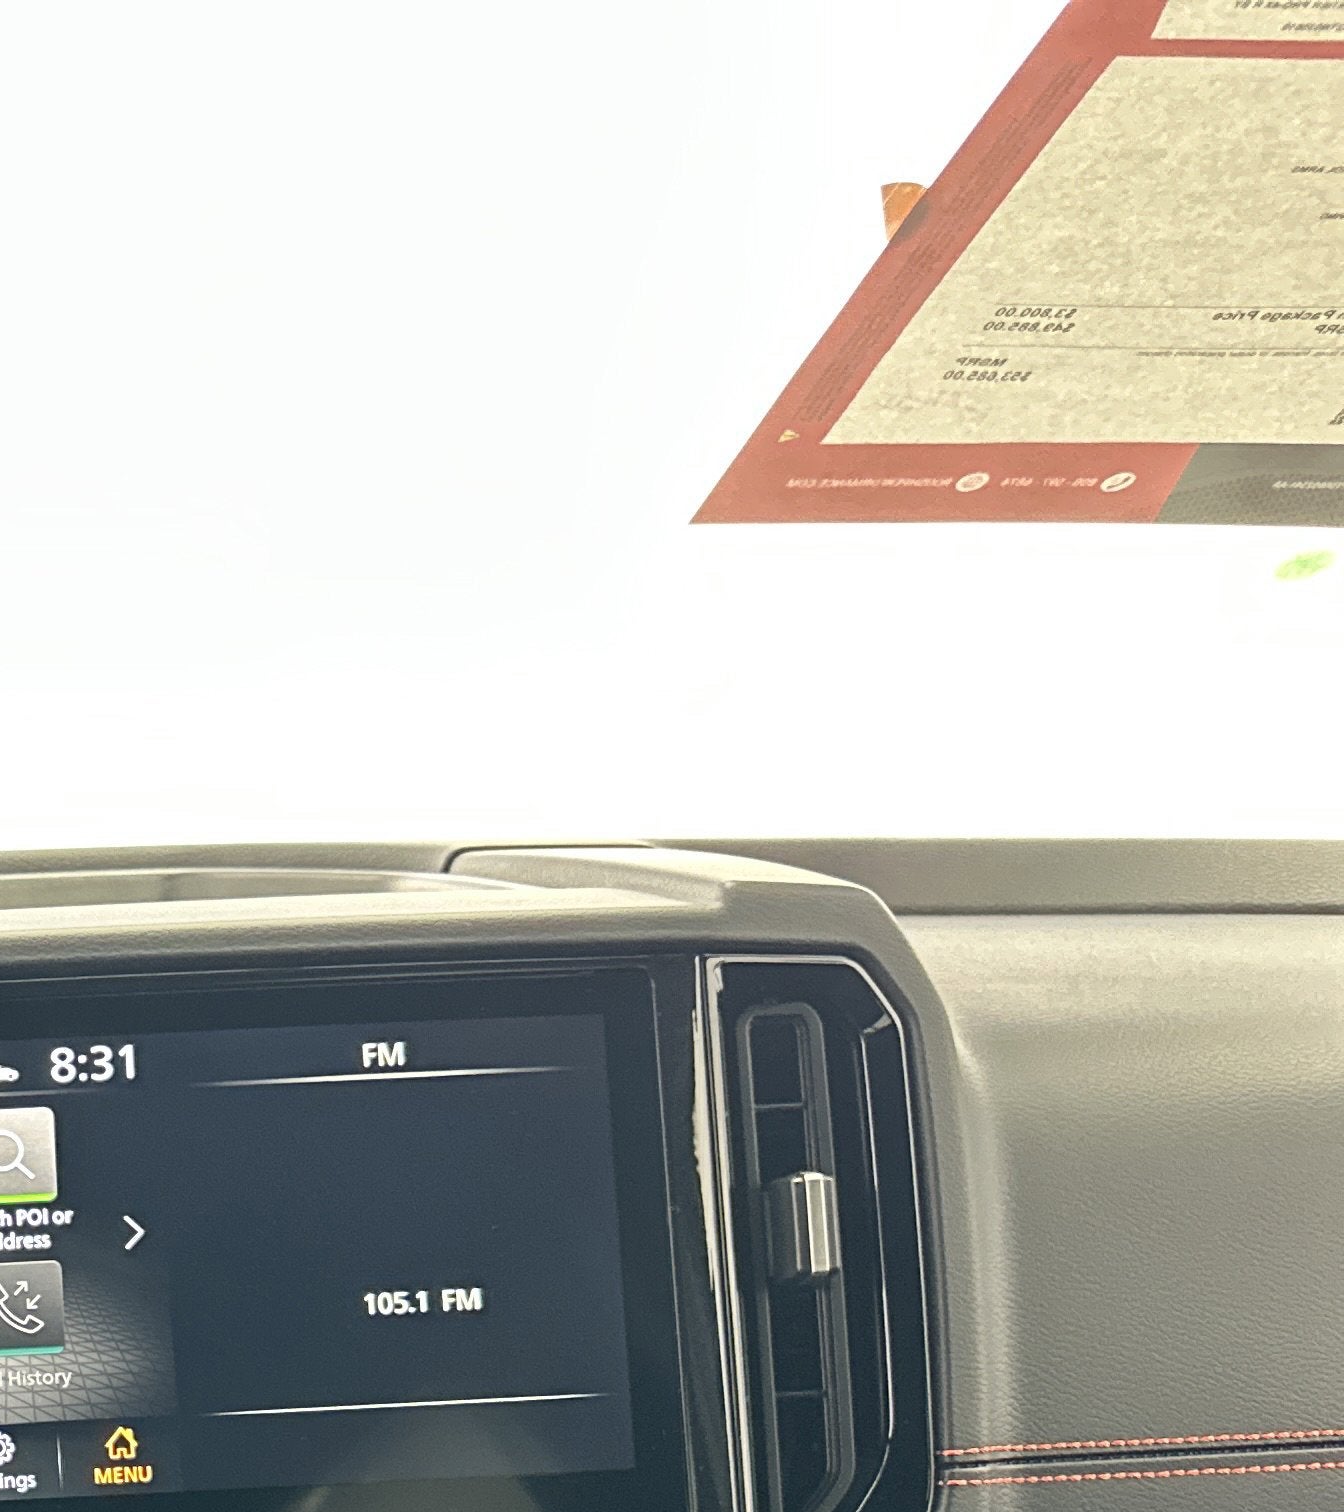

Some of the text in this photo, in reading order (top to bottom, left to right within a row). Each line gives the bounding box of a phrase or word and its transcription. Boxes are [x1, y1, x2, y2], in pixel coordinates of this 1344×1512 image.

[50, 1044, 138, 1083] 8:31
[362, 1043, 407, 1067] FM
[15, 1208, 48, 1228] POI
[52, 1211, 74, 1226] or
[363, 1287, 483, 1317] 105.1 FM
[7, 1368, 72, 1389] History
[93, 1466, 153, 1485] MENU
